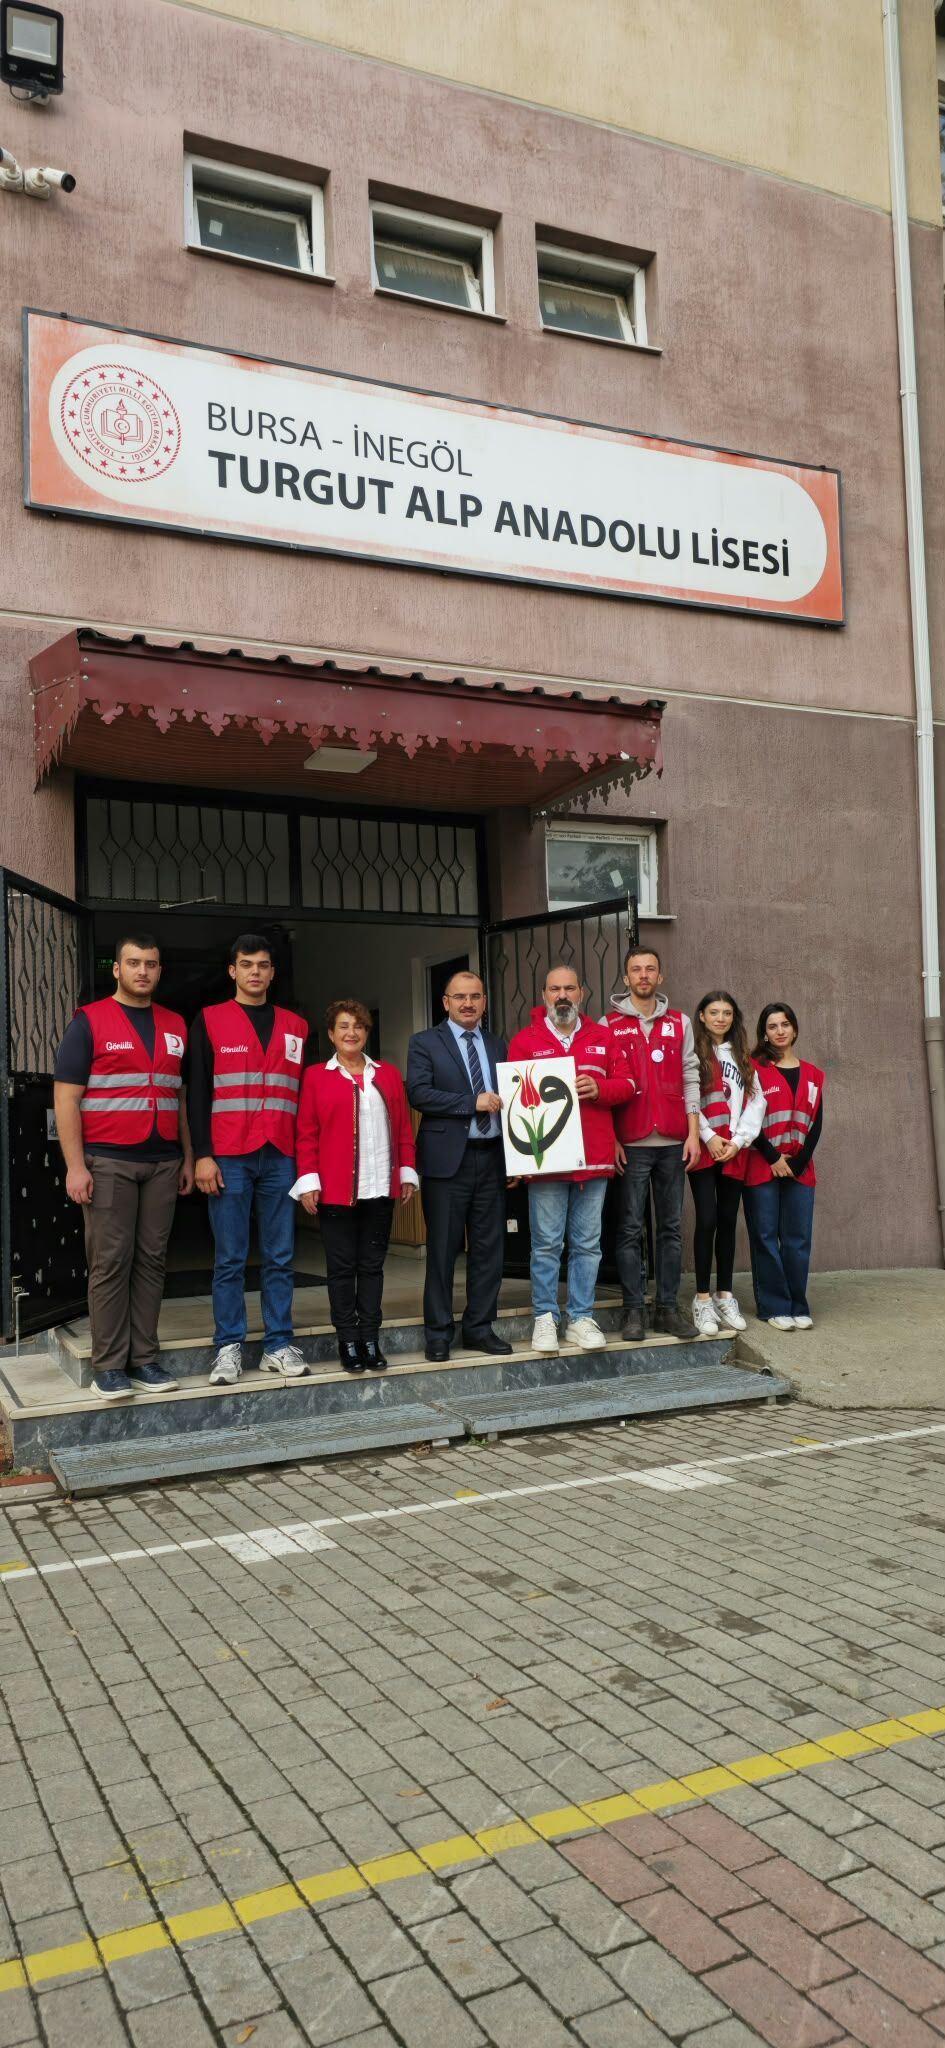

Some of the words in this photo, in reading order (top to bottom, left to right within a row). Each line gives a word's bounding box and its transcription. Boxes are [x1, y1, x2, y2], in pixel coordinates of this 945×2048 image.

[207, 402, 322, 450] BURSA
[353, 424, 473, 477] İNEGÖL
[208, 450, 394, 515] TURGUT
[405, 486, 483, 528] ALP
[494, 501, 681, 560] ANADOLU
[692, 528, 790, 577] LİSESİ
